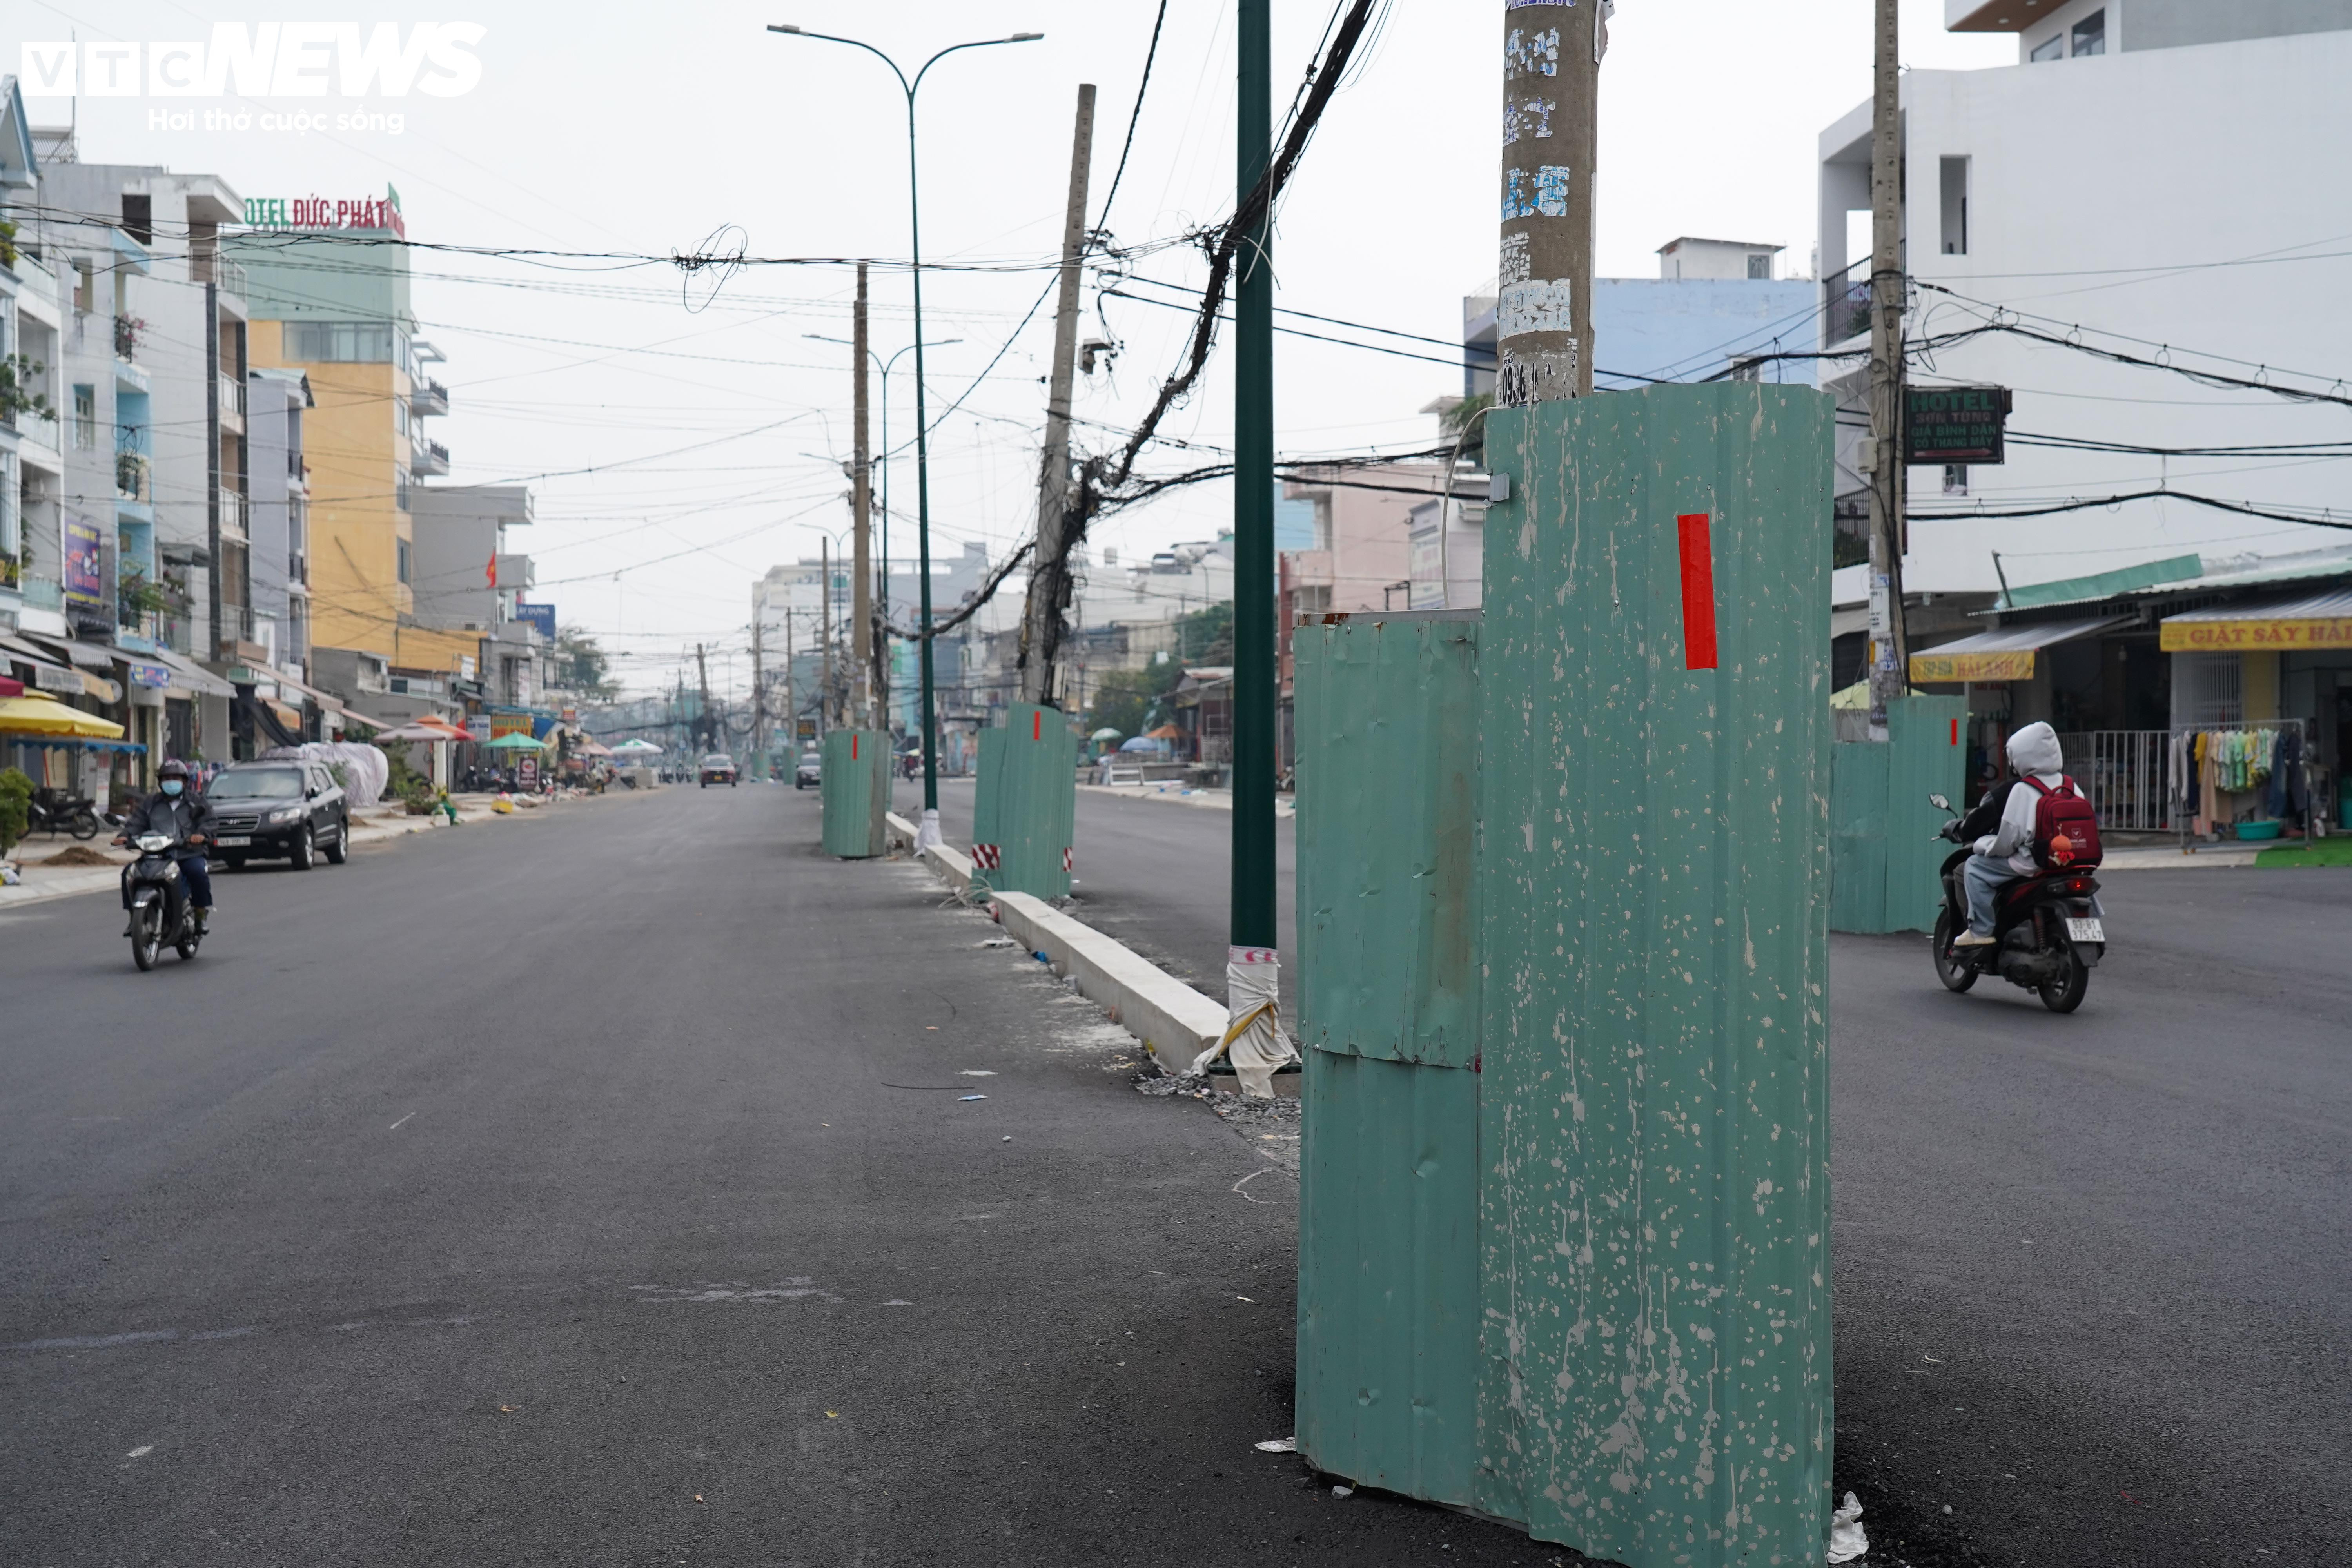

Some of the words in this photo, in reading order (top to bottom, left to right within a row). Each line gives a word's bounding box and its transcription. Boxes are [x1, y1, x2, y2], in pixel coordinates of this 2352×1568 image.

[245, 198, 290, 227] OTEL
[293, 193, 330, 227] ĐỨC
[338, 194, 385, 228] PHÁT
[1504, 356, 1514, 365] RÚ
[1911, 392, 1995, 412] HOTEL
[1916, 412, 1946, 423] SƠN
[1951, 411, 1991, 423] TÙNG
[1911, 424, 1931, 437] GIÁ
[1936, 423, 1967, 436] BÌNH
[1971, 423, 1996, 435] DÂN
[1915, 437, 1929, 448] CÓ
[1933, 437, 1967, 448] THANG
[2190, 624, 2245, 646] GIẶT
[2253, 621, 2301, 642] SẤY
[1957, 655, 1981, 677] HẢI
[1984, 660, 2014, 676] ANH
